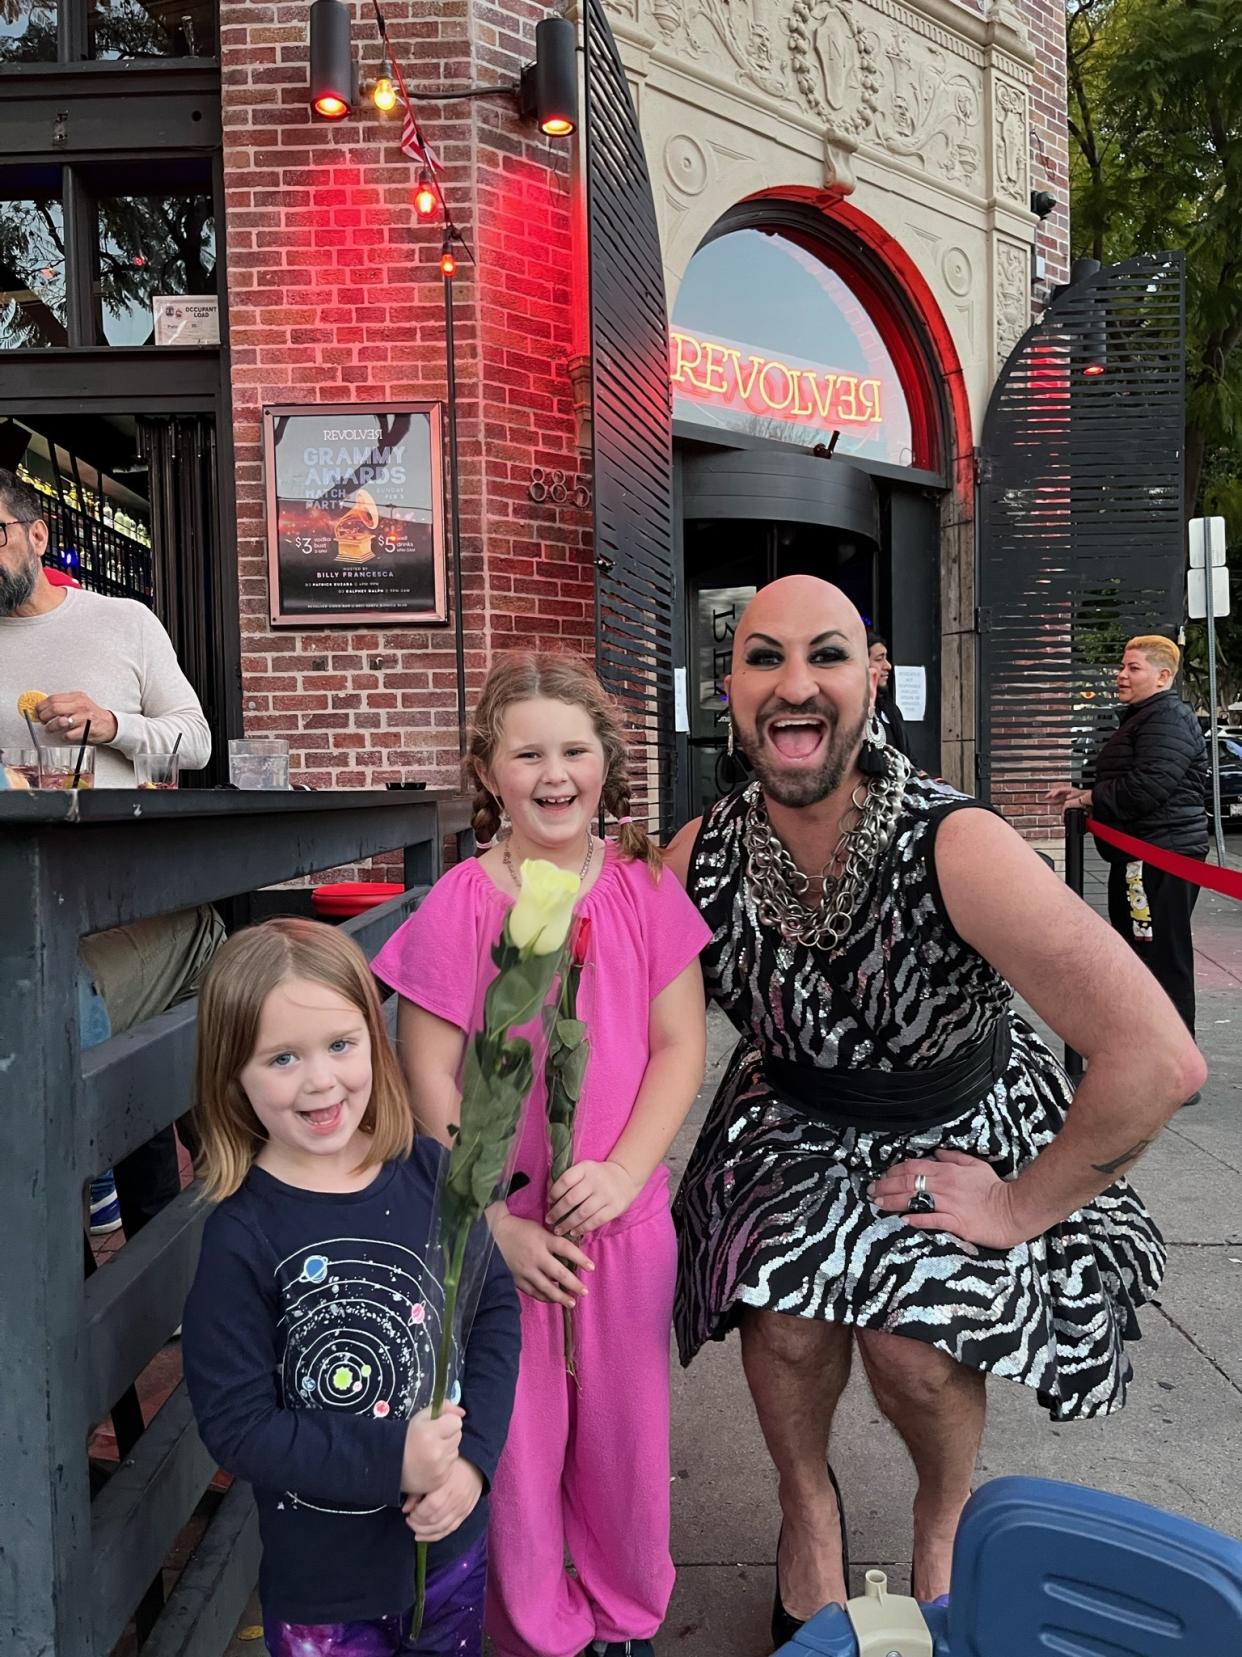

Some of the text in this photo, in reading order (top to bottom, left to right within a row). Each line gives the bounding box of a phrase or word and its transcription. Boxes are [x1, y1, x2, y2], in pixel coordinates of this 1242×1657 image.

[670, 333, 883, 422] REVOLVER
[323, 429, 383, 441] REVOLVER
[303, 446, 406, 465] GRAMMY
[305, 466, 406, 485] AWARDS
[305, 489, 346, 499] WATCH
[529, 465, 593, 508] 885
[305, 500, 345, 510] PARTY
[295, 536, 313, 554] $3
[378, 535, 396, 553] $5
